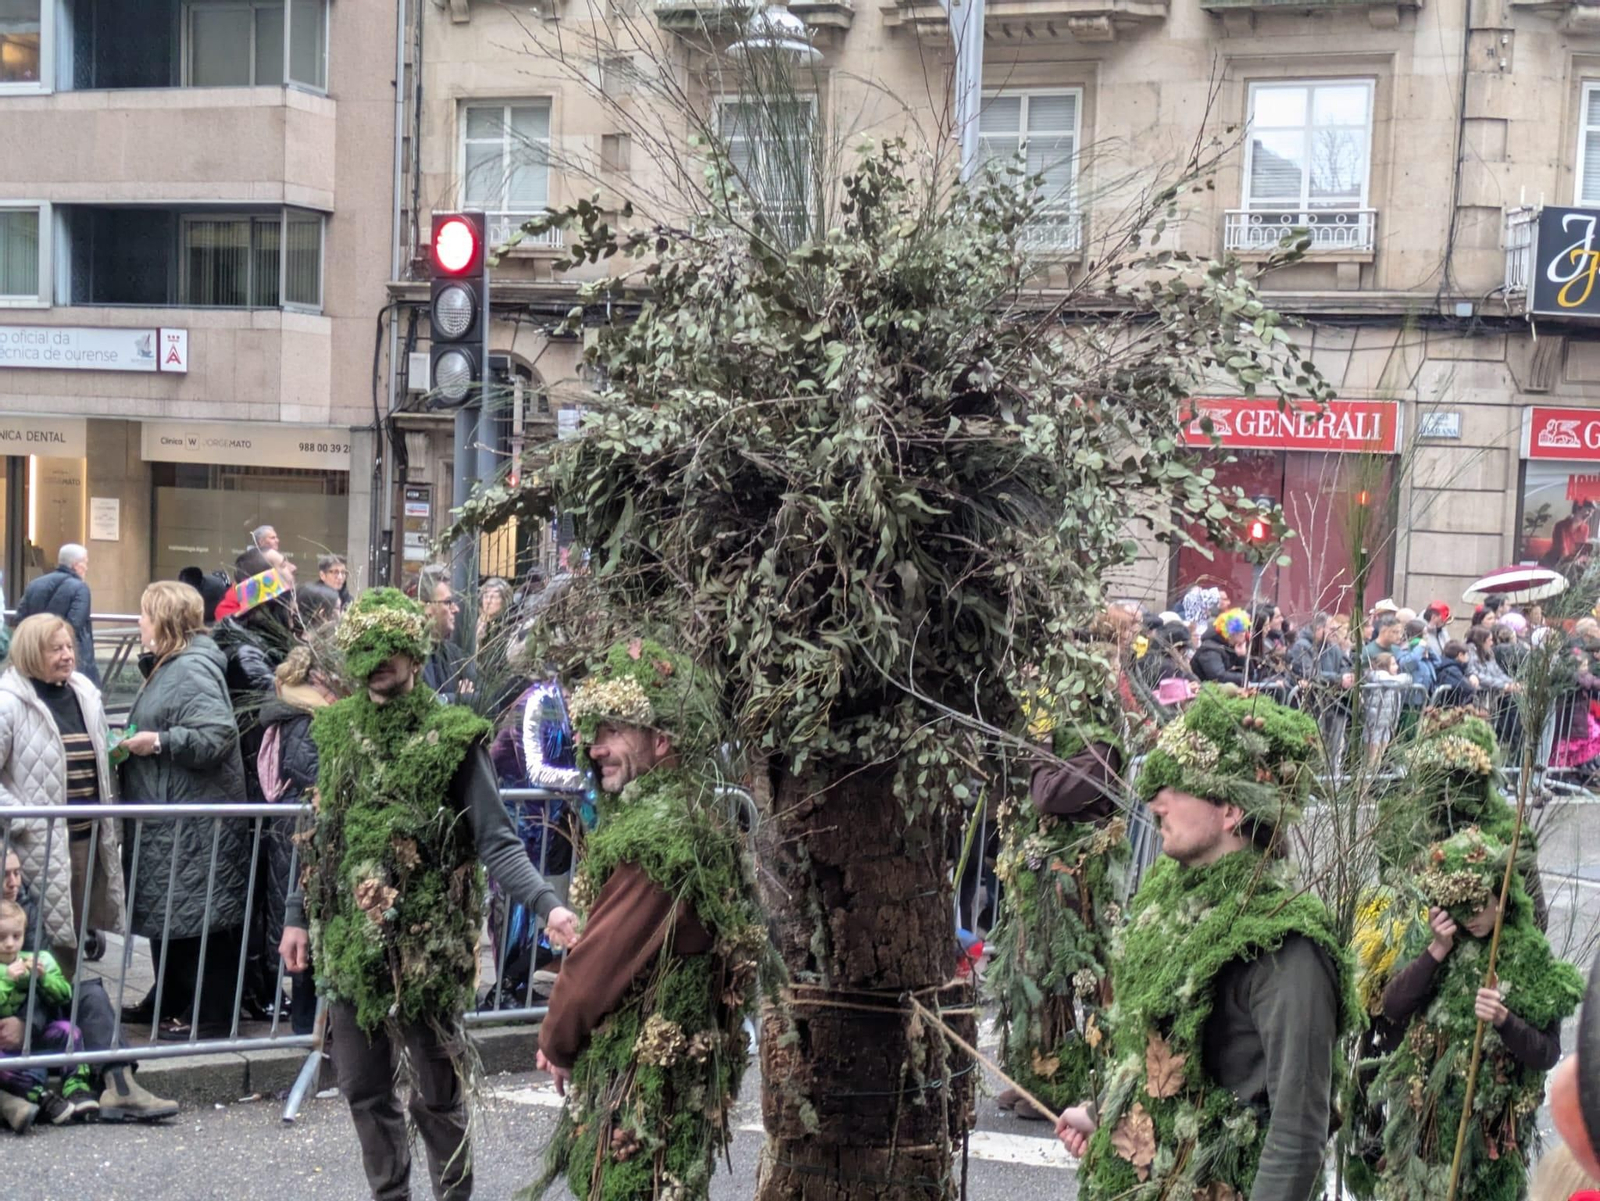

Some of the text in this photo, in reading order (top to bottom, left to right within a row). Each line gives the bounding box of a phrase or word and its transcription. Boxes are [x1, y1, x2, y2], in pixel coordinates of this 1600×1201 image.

[11, 329, 49, 345] oficial
[53, 331, 70, 345] da
[44, 346, 61, 361] de
[66, 348, 118, 363] ourense
[1235, 409, 1382, 440] GENERALI
[26, 431, 66, 443] DENTAL
[298, 443, 315, 452] 988
[317, 443, 328, 453] 00
[330, 444, 341, 453] 39
